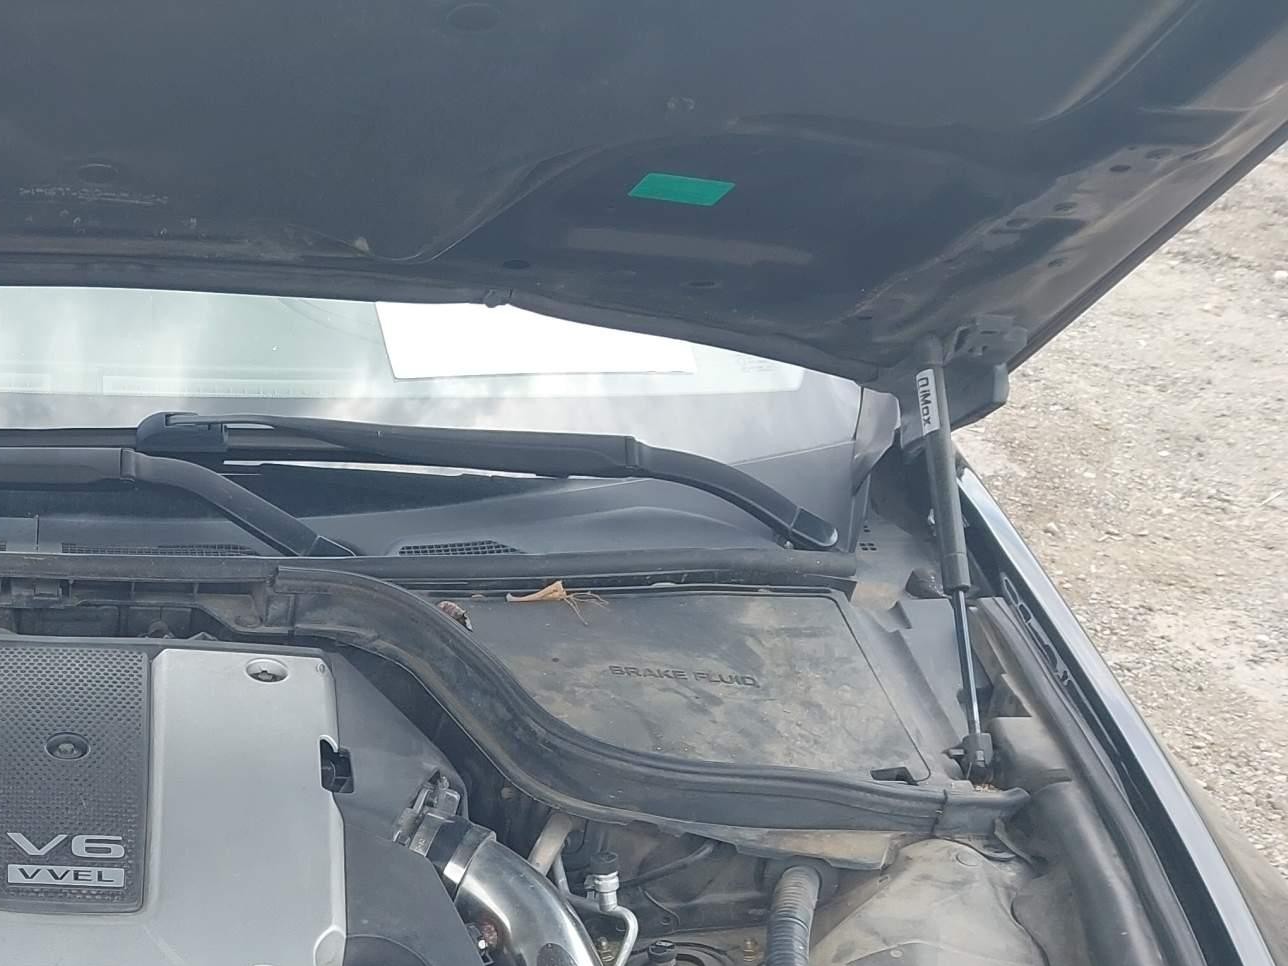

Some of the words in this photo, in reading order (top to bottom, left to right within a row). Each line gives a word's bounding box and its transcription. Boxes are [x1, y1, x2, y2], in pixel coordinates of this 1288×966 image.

[609, 664, 688, 681] BRAKE
[693, 671, 759, 688] FLUID
[6, 832, 125, 858] V6
[18, 867, 115, 883] VVEL
